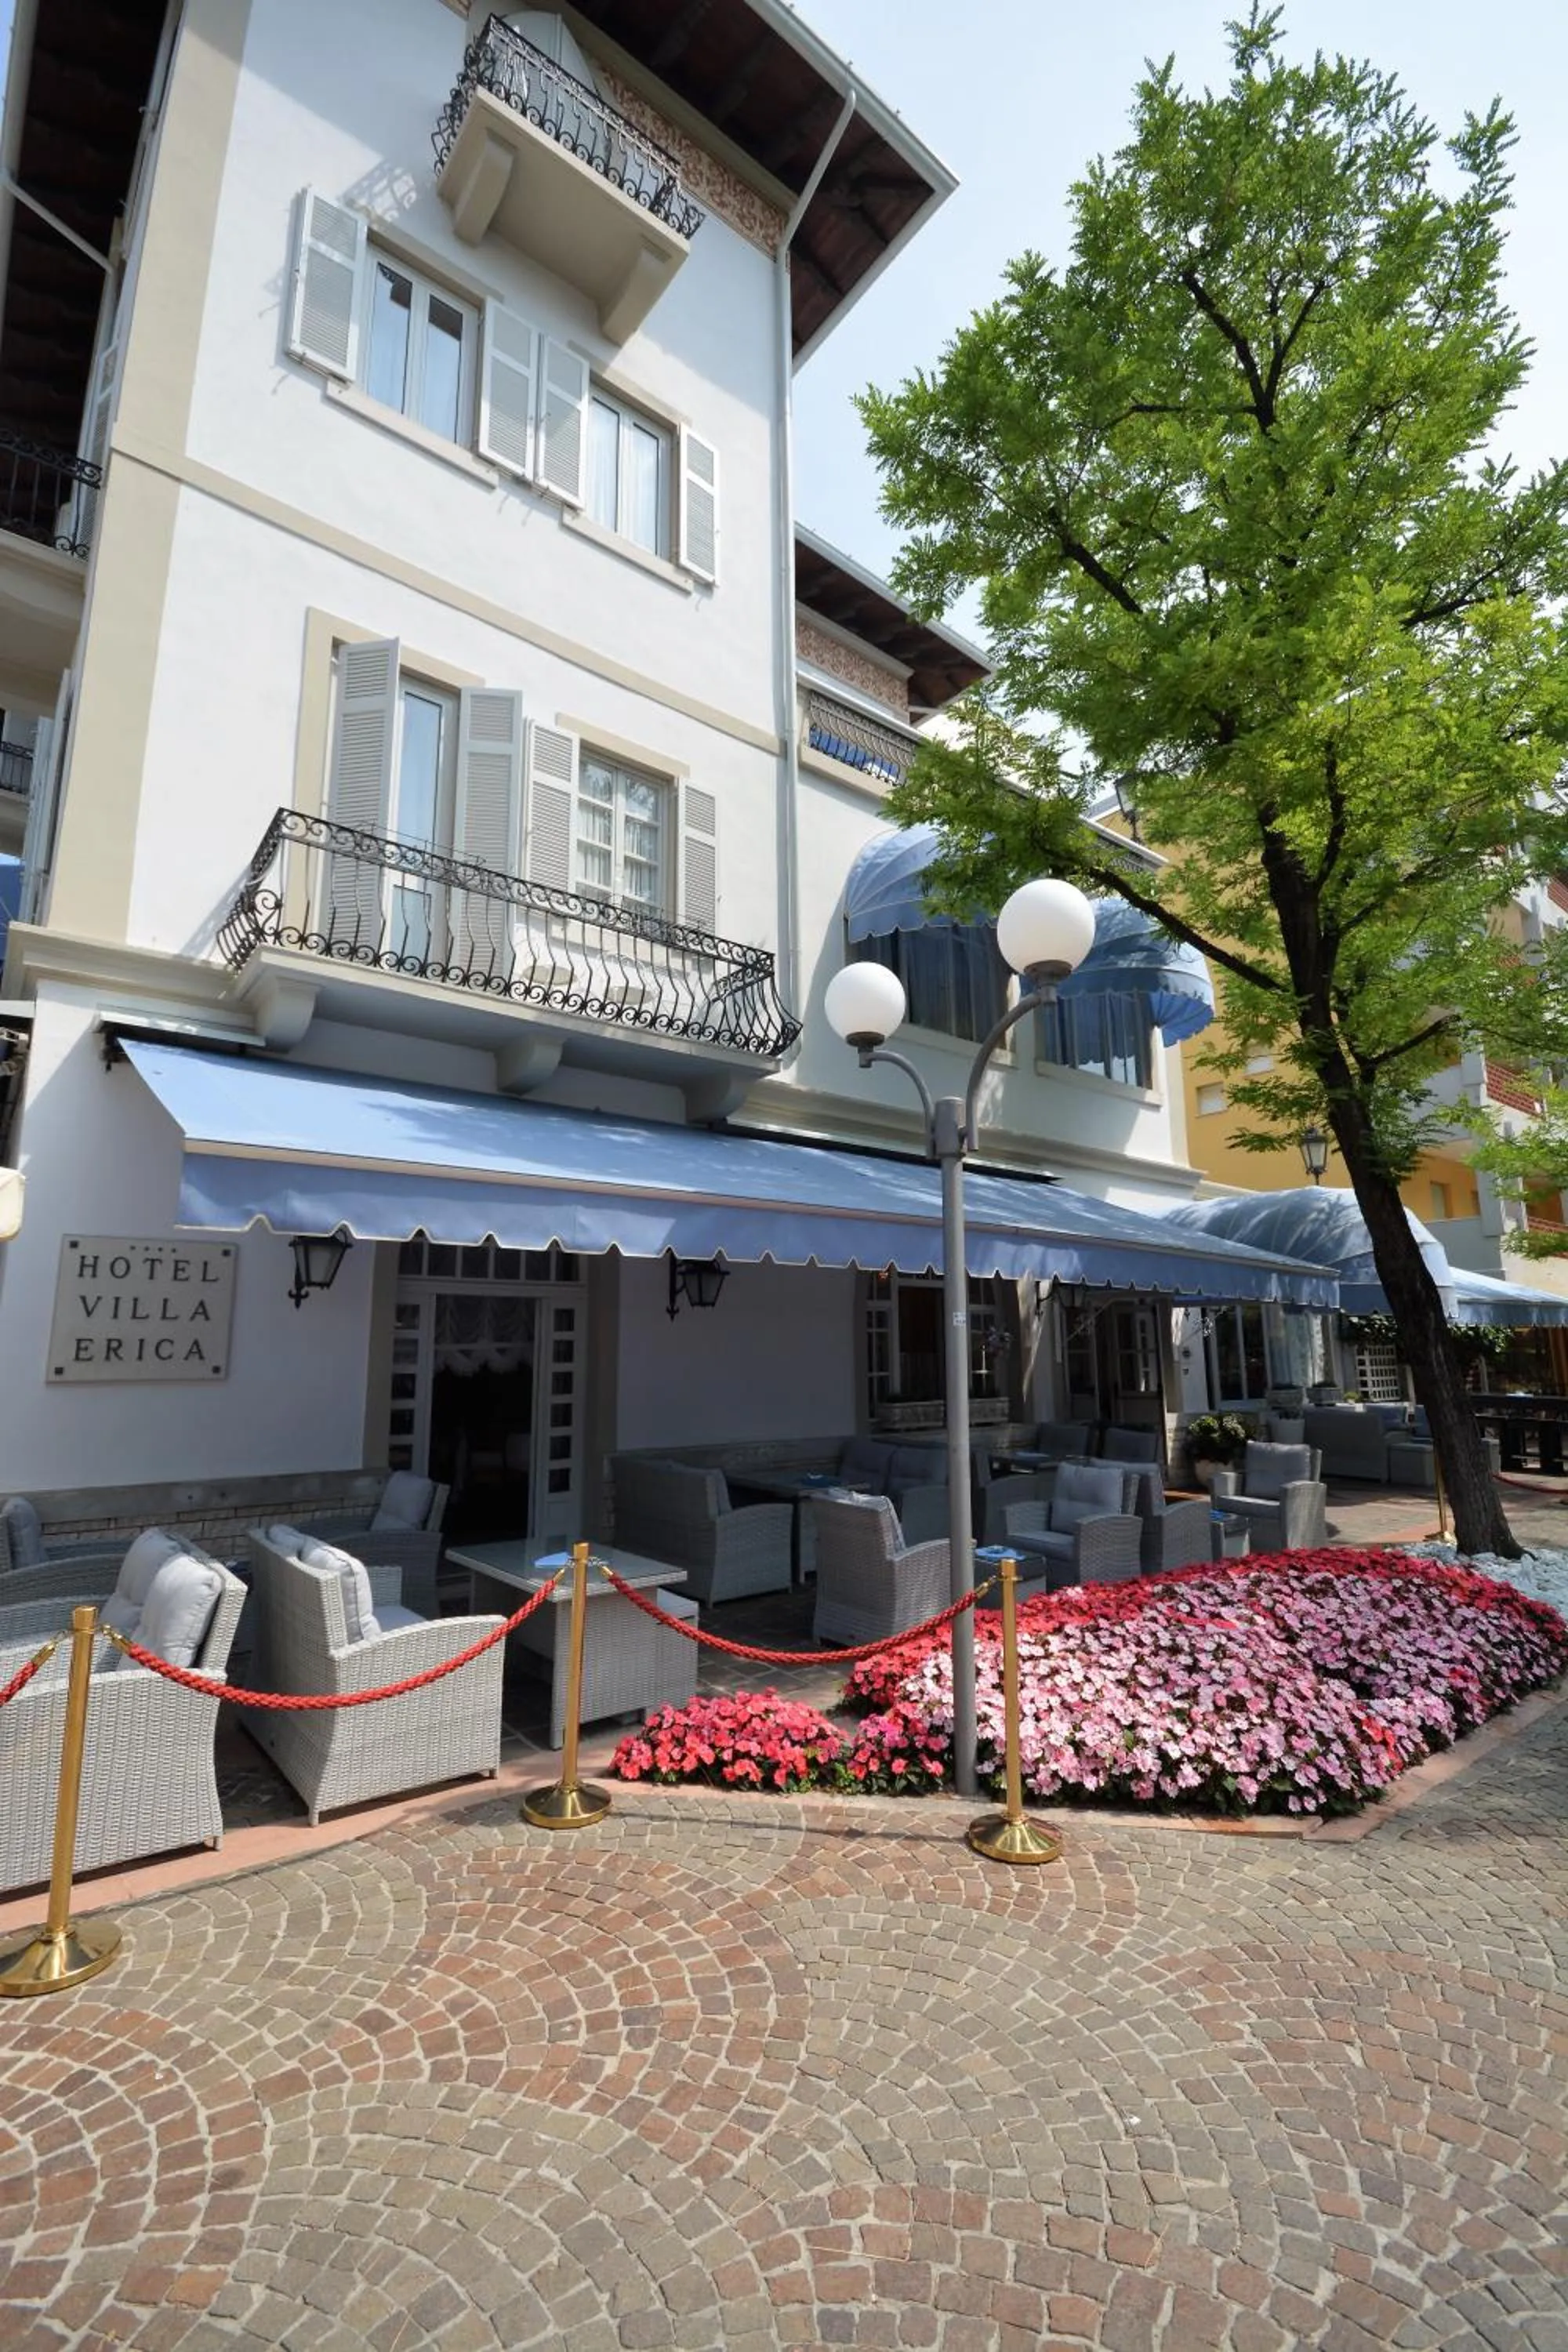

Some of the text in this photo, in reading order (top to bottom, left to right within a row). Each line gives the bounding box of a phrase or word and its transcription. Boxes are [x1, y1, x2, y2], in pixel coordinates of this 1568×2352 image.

[78, 1255, 220, 1282] HOTEL
[79, 1295, 211, 1321] VILLA
[73, 1338, 205, 1362] ERICA
